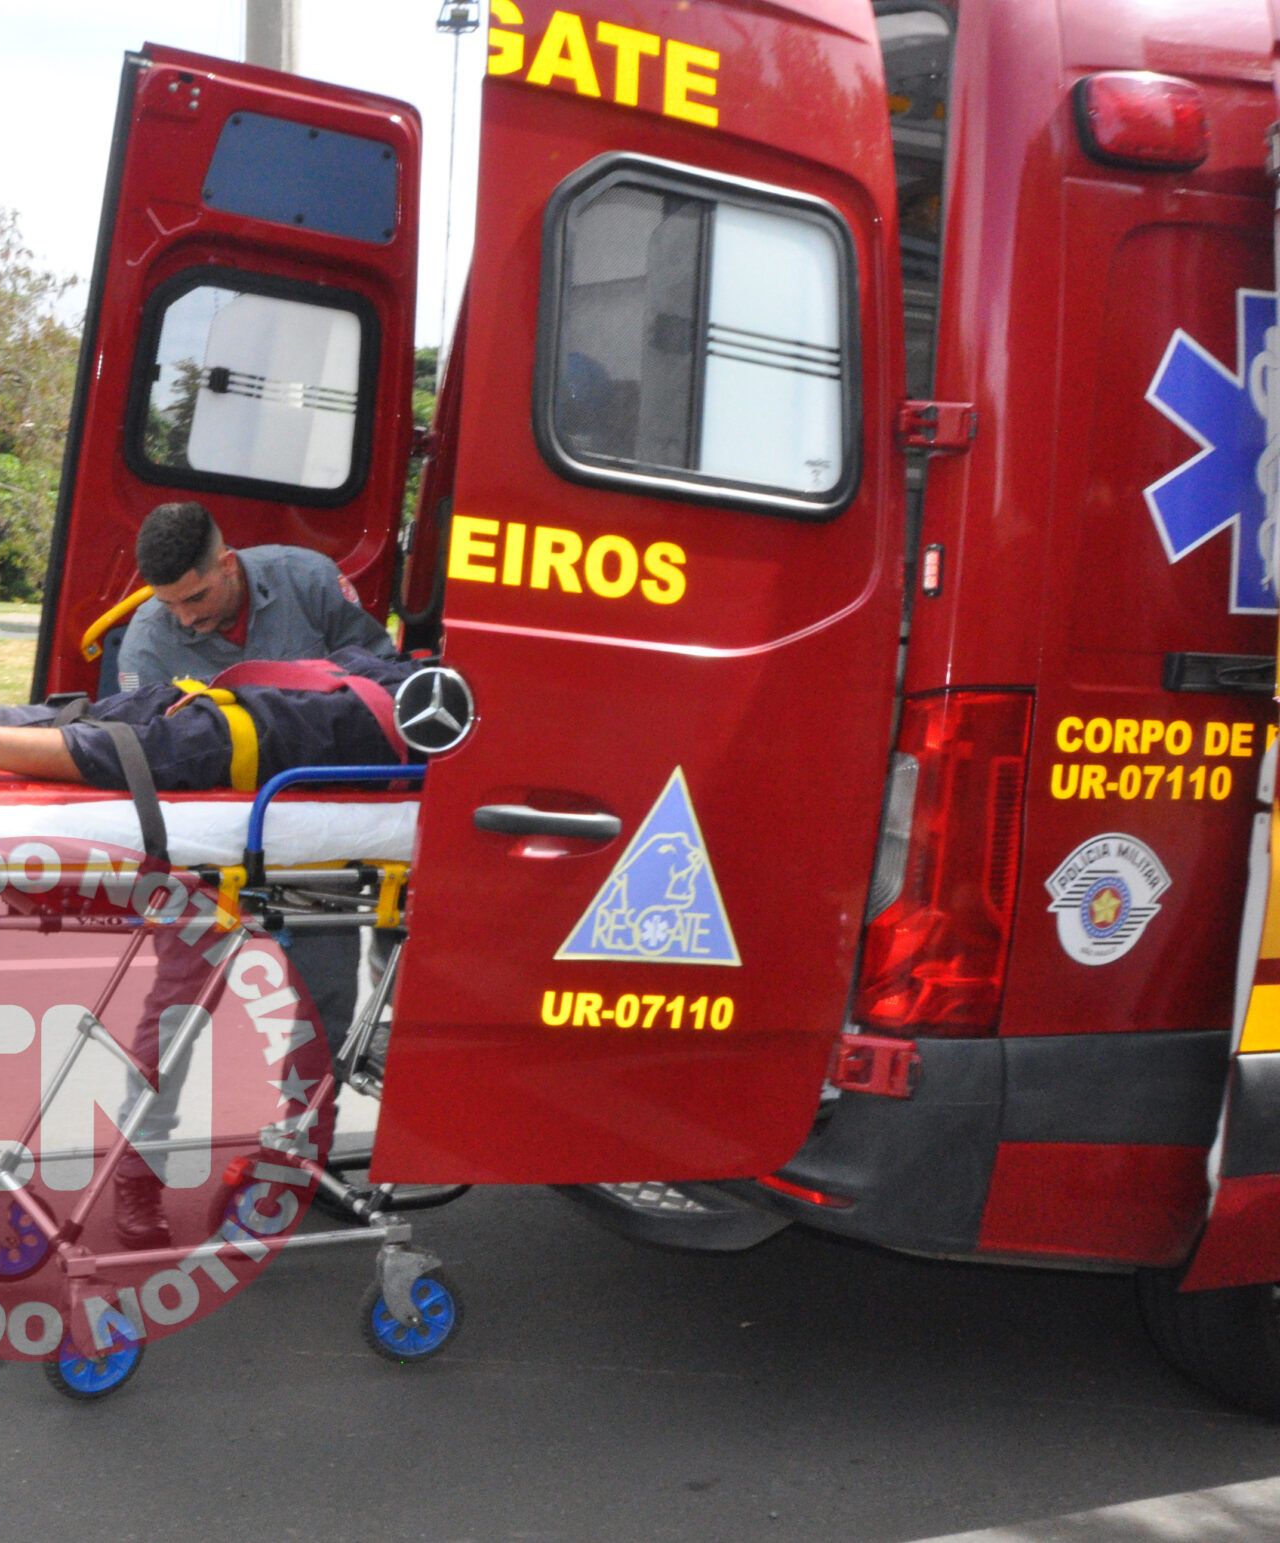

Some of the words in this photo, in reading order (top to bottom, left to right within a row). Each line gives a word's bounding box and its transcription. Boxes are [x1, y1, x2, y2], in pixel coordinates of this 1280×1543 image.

[488, 0, 720, 127] GATE
[448, 515, 687, 605] EIROS
[1056, 716, 1193, 756] CORPO
[1204, 721, 1254, 757] DE
[1050, 763, 1232, 801] UR-07110
[1117, 843, 1161, 890] MILITAR
[591, 906, 711, 956] RESGATE
[541, 991, 734, 1030] UR-07110
